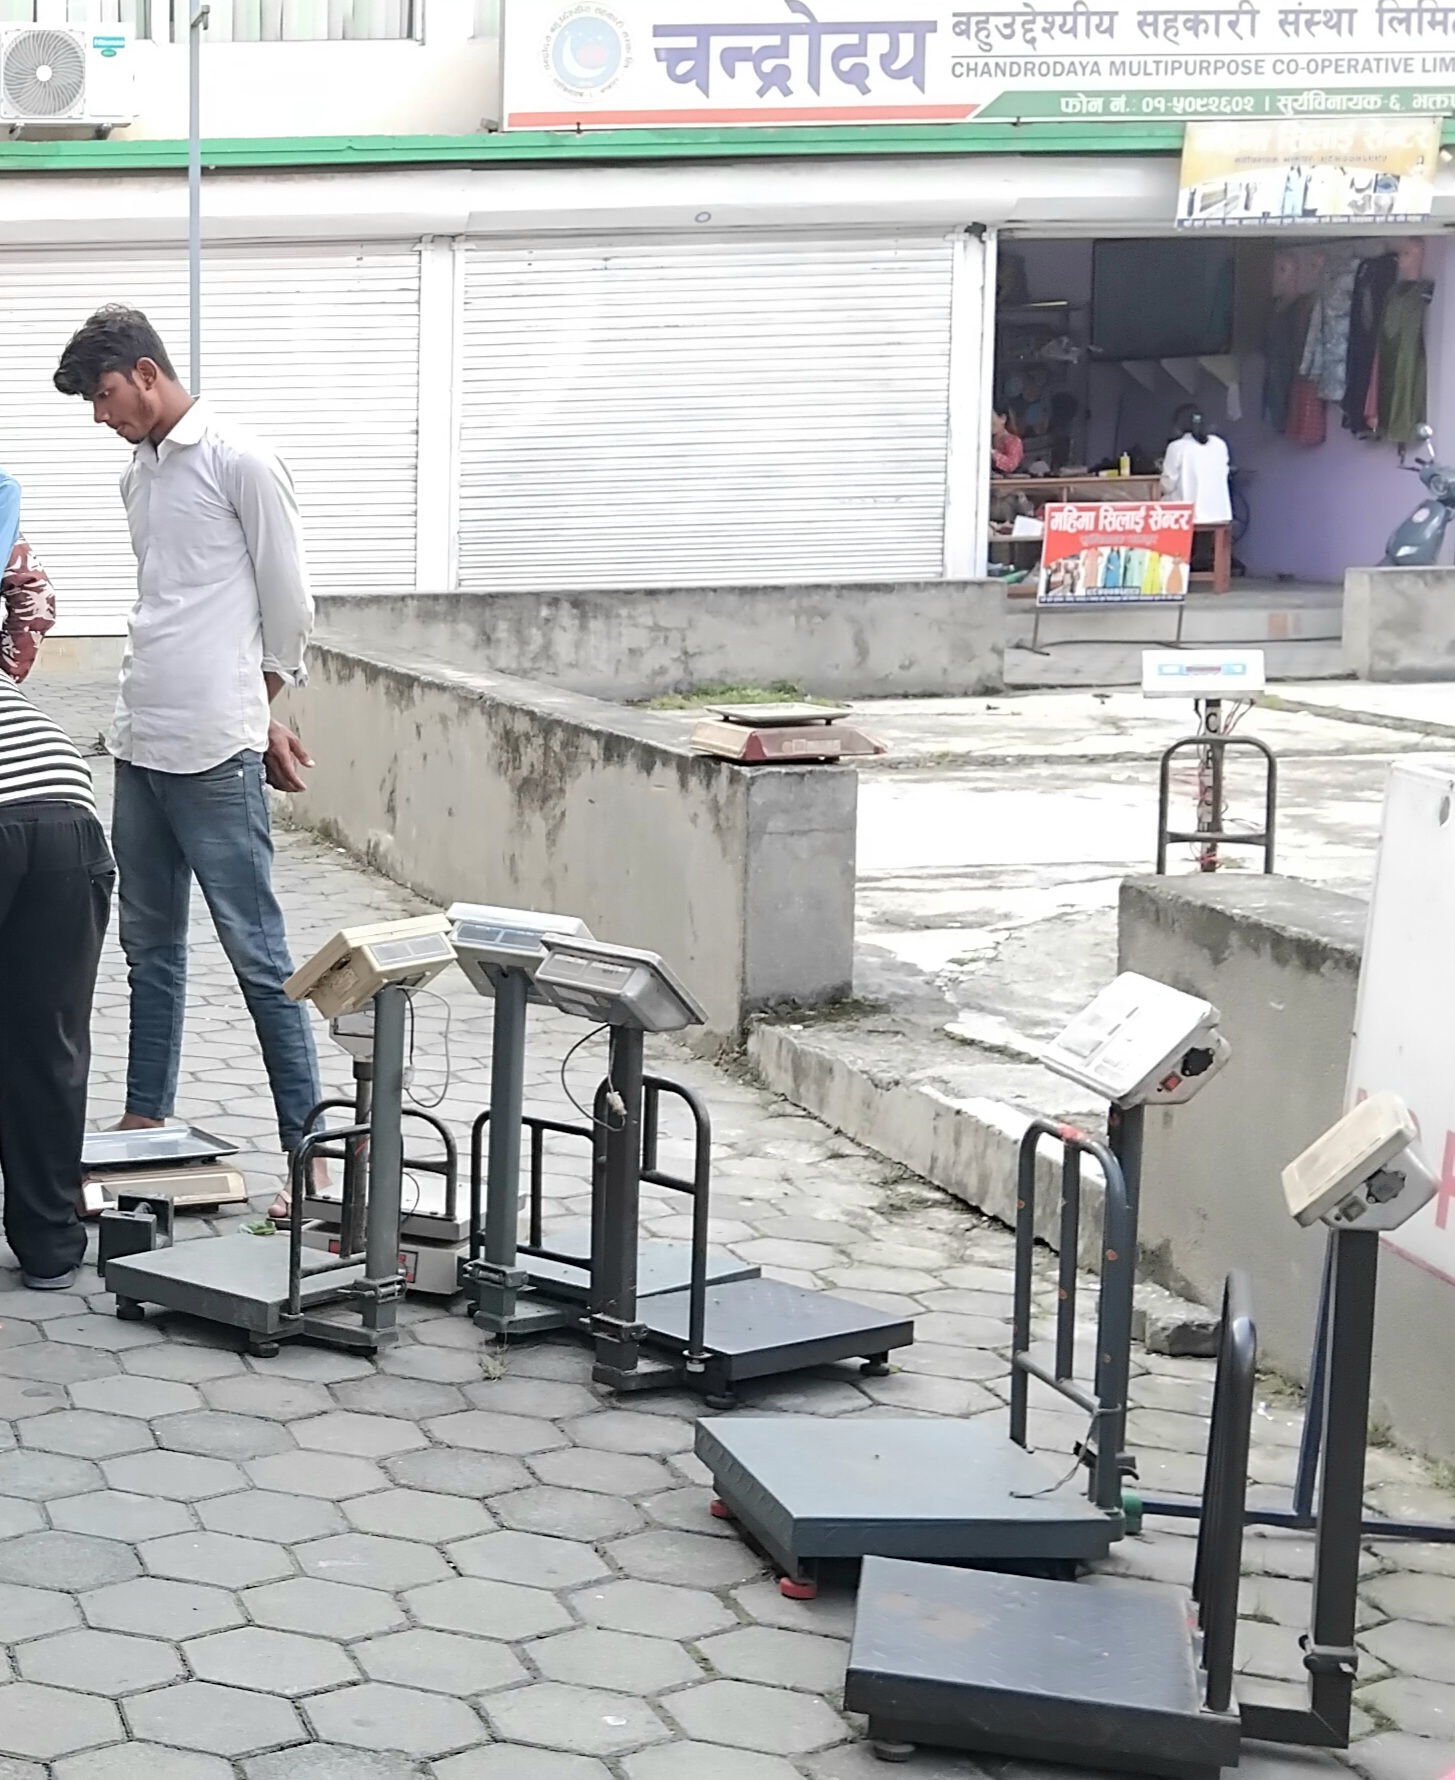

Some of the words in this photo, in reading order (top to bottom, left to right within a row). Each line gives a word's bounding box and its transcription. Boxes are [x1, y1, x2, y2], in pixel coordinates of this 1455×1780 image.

[952, 0, 1119, 52] बहुउद्देश्यीय
[1137, 0, 1260, 46] सहकारी
[1278, 2, 1358, 38] संस्था
[1376, 0, 1455, 37] लिमि
[653, 0, 937, 98] चन्द्रोदय
[951, 60, 1101, 78] CHANDRODAYA
[1109, 59, 1265, 77] MULTIPURPOSE
[1272, 57, 1415, 76] CO-OPERATIVE
[1060, 93, 1103, 114] फोन
[1050, 505, 1096, 533] महिमा
[1098, 505, 1146, 533] सिलाई
[1149, 505, 1192, 531] सेन्टर
